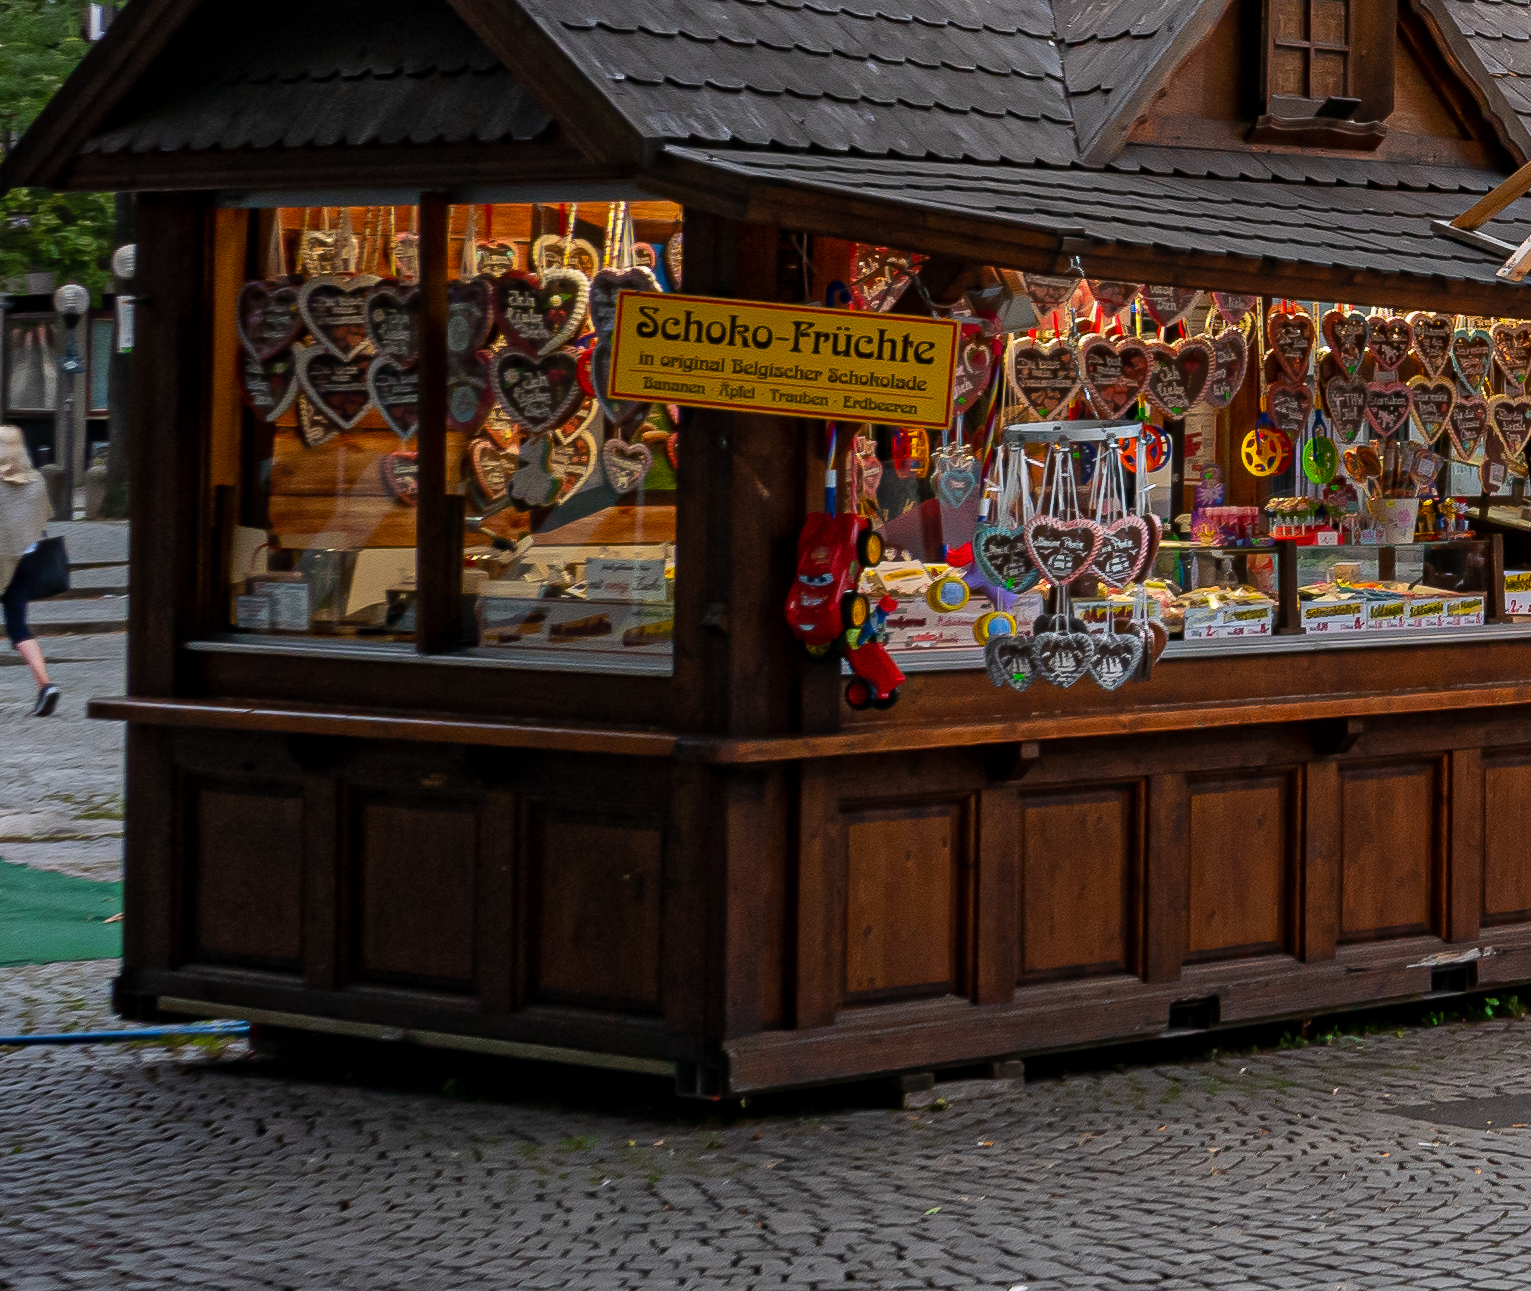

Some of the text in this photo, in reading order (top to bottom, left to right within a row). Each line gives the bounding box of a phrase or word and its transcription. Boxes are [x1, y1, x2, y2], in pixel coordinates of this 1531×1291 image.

[635, 305, 936, 365] Schoko-Früchte
[639, 350, 928, 392] in original Belgischer Schokolade
[642, 376, 706, 395] Bananen
[769, 388, 829, 407] Trauben
[842, 395, 918, 415] Erdbeeren
